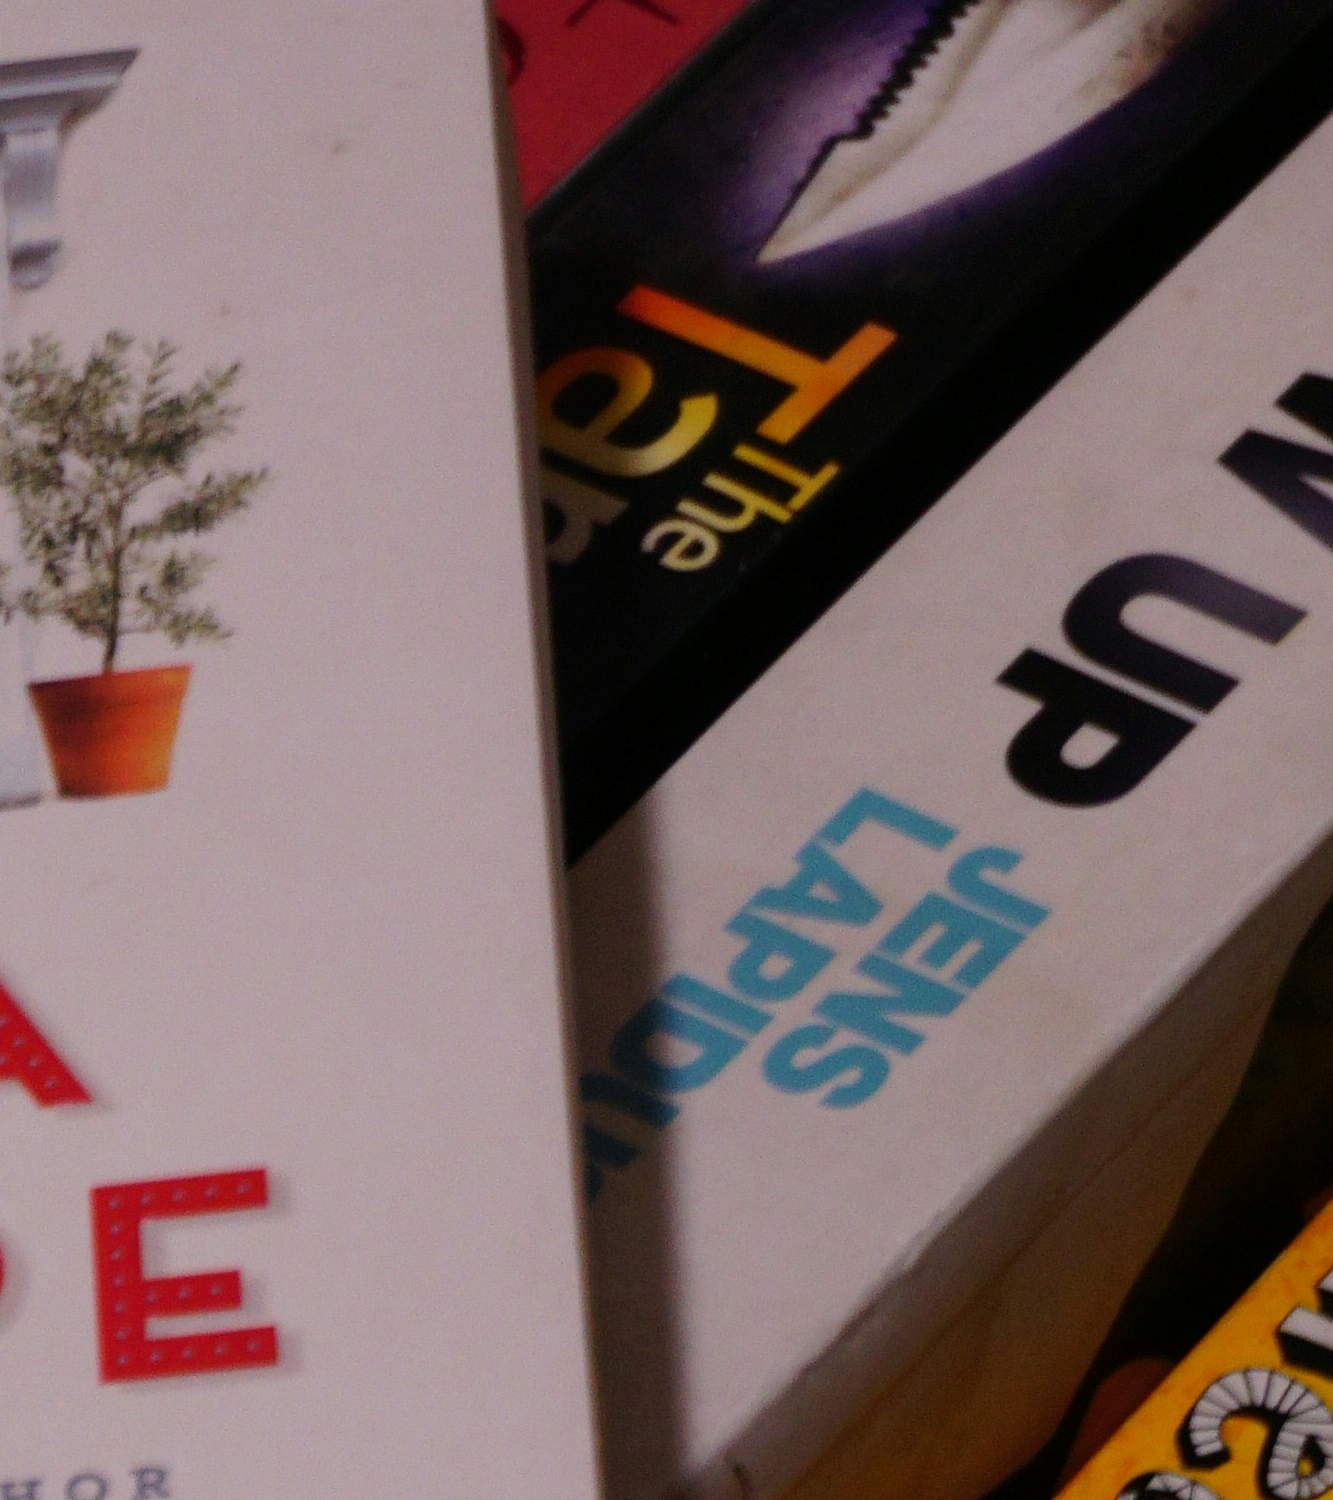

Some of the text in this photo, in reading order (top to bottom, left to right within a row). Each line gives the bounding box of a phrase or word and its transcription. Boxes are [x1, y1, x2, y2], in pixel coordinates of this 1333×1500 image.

[640, 442, 841, 573] The
[995, 552, 1308, 808] UP
[761, 846, 1051, 1111] JENS
